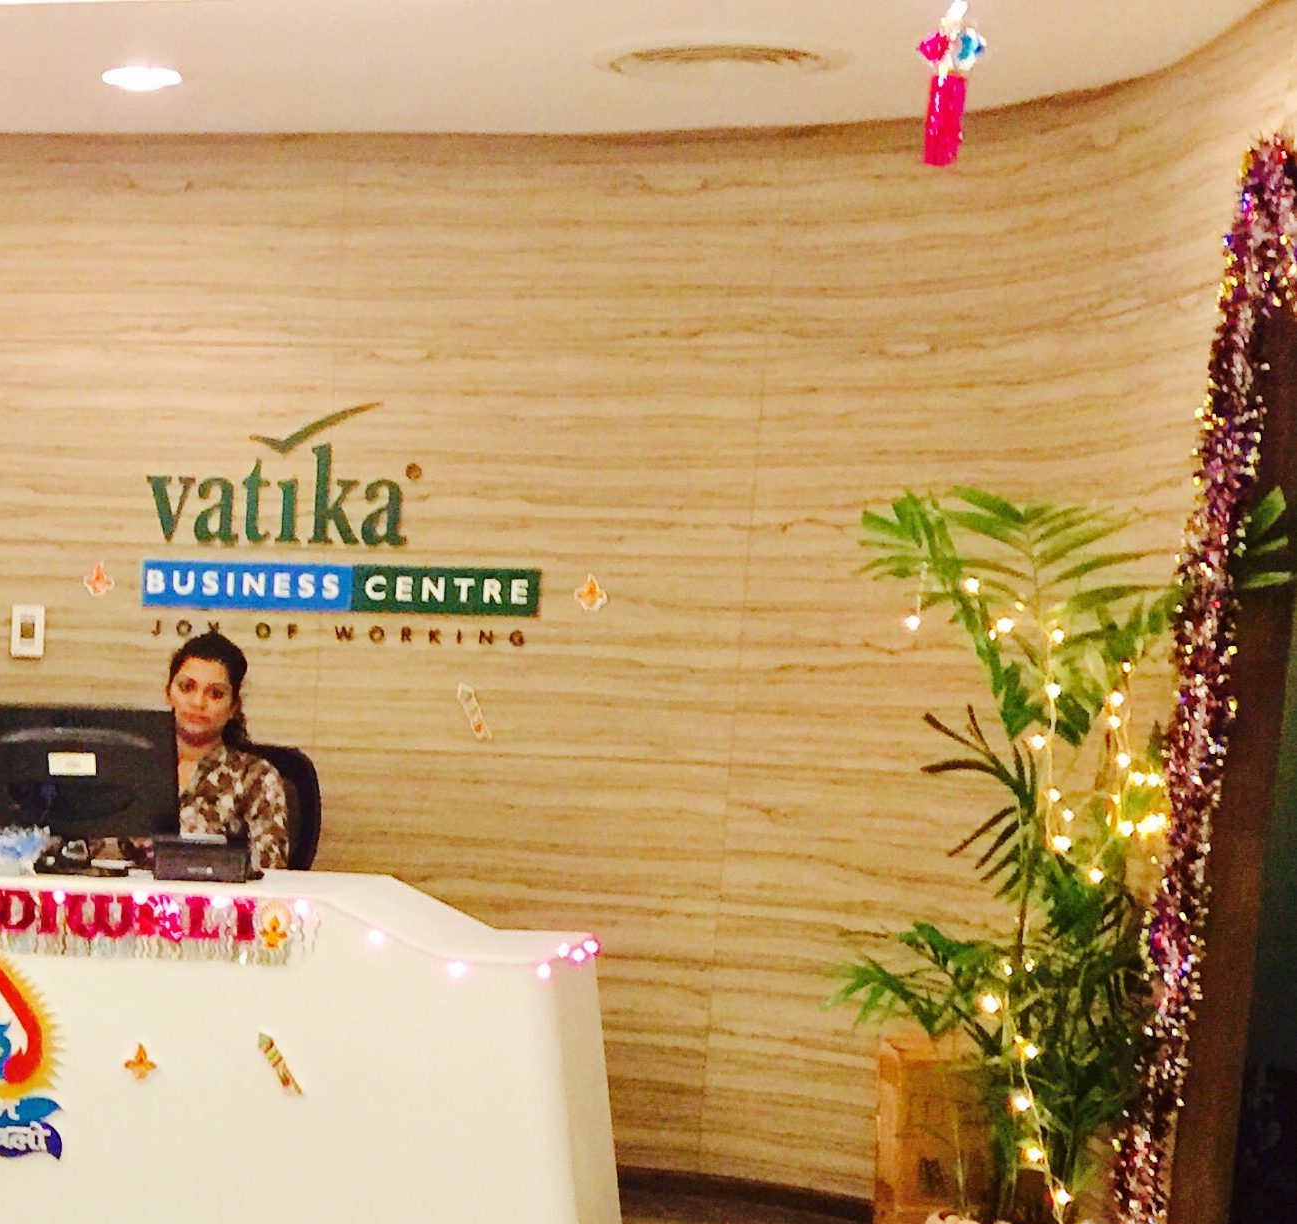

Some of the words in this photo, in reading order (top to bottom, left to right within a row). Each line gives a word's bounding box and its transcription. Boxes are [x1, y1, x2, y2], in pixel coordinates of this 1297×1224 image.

[146, 440, 407, 547] vatika
[146, 568, 340, 599] BUSINESS
[365, 575, 529, 605] CENTRE
[151, 619, 220, 637] JOY
[255, 622, 299, 640] OF
[334, 624, 526, 647] WORKING
